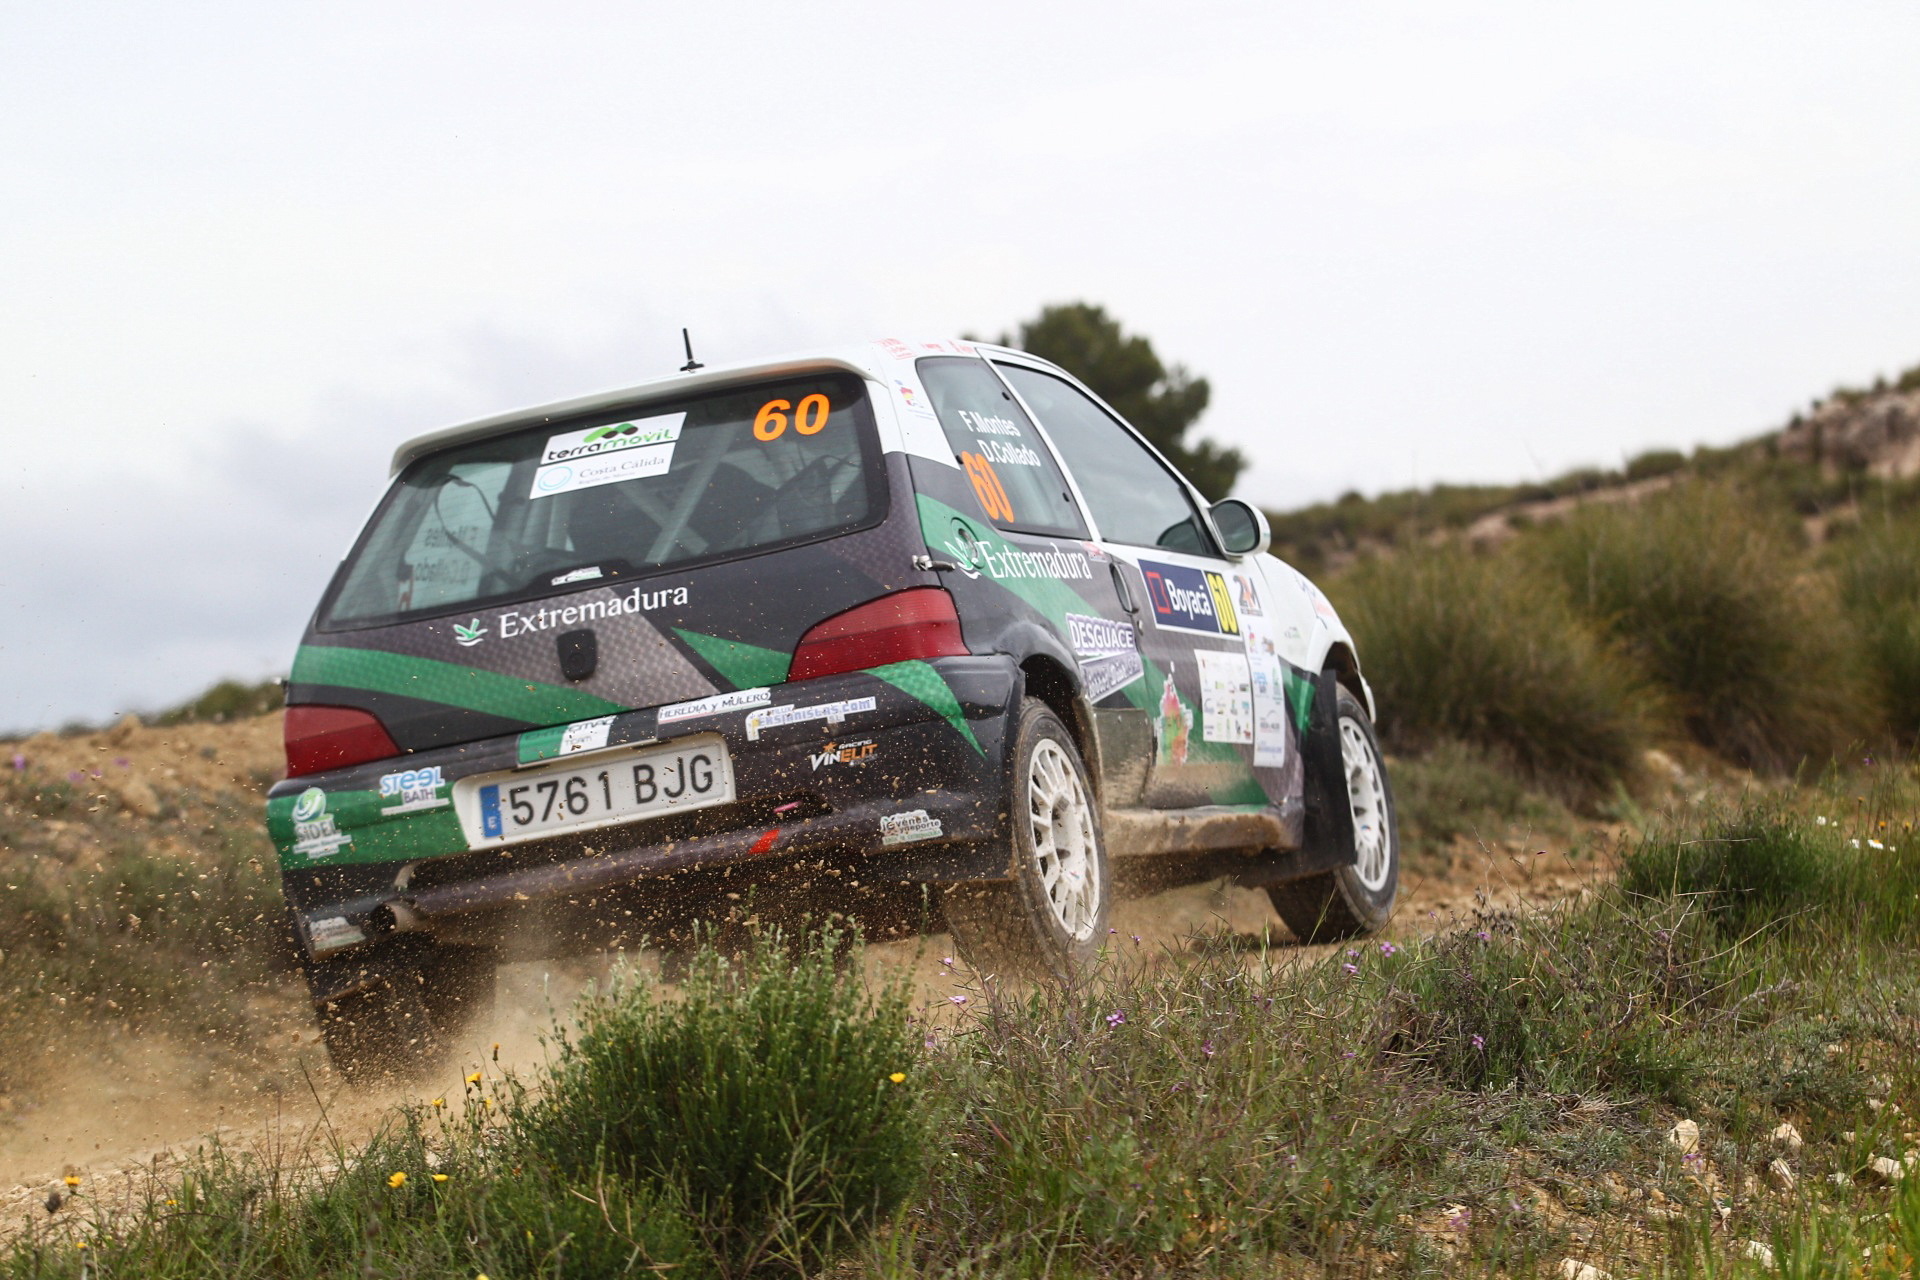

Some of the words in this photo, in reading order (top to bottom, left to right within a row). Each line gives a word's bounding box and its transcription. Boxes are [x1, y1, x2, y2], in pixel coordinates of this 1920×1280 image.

[753, 394, 831, 441] 60
[958, 410, 1021, 437] F.Montes
[548, 429, 673, 460] terramovil
[977, 439, 1041, 467] D.Collado
[580, 467, 617, 478] Costa
[621, 457, 665, 470] Cálida
[962, 451, 1014, 523] 60
[976, 541, 1093, 580] Extremadura
[500, 585, 689, 639] Extremadura
[1207, 573, 1237, 634] 60
[1069, 620, 1133, 648] DESGUACE
[660, 703, 706, 720] HEREDIA
[722, 691, 771, 708] MULERO
[403, 788, 435, 804] BATH
[509, 771, 612, 825] 5761
[633, 754, 713, 804] BJG
